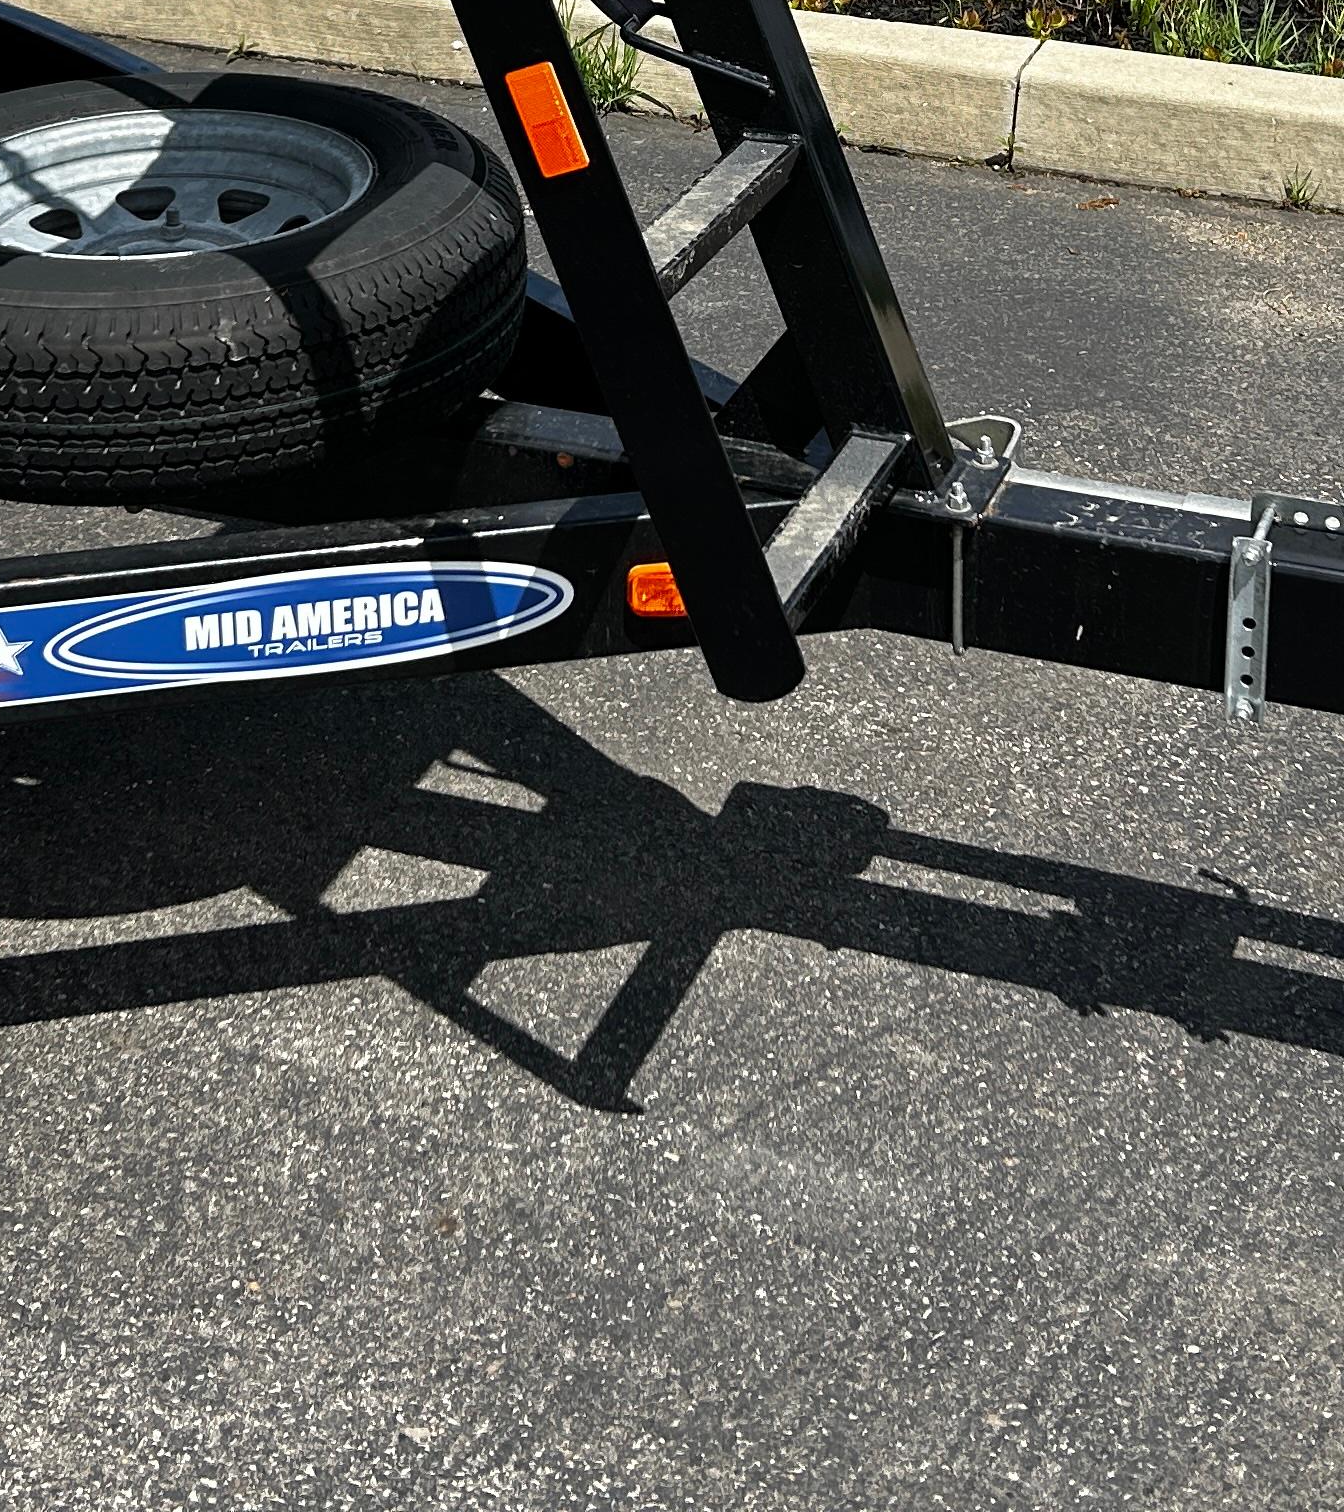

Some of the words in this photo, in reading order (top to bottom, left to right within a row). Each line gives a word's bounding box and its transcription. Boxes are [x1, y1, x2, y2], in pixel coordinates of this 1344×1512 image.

[184, 608, 263, 652] MID
[270, 588, 446, 641] AMERICA
[247, 630, 384, 658] TRAILERS
